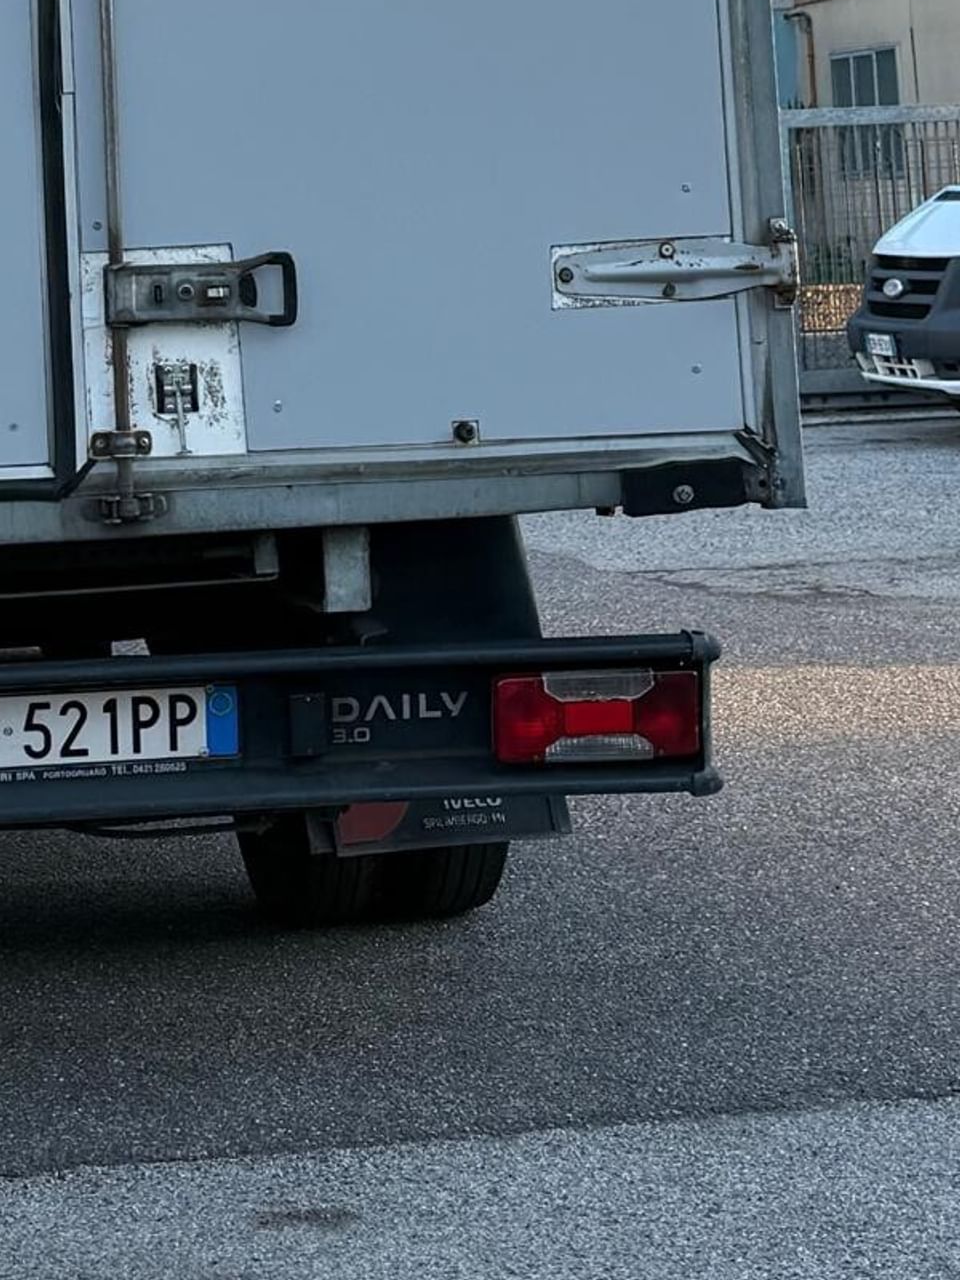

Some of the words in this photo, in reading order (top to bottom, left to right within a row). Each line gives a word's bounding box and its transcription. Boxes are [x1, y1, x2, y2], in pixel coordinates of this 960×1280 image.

[331, 691, 469, 723] DAILY
[23, 693, 198, 760] 521PP
[332, 727, 370, 743] 3.0
